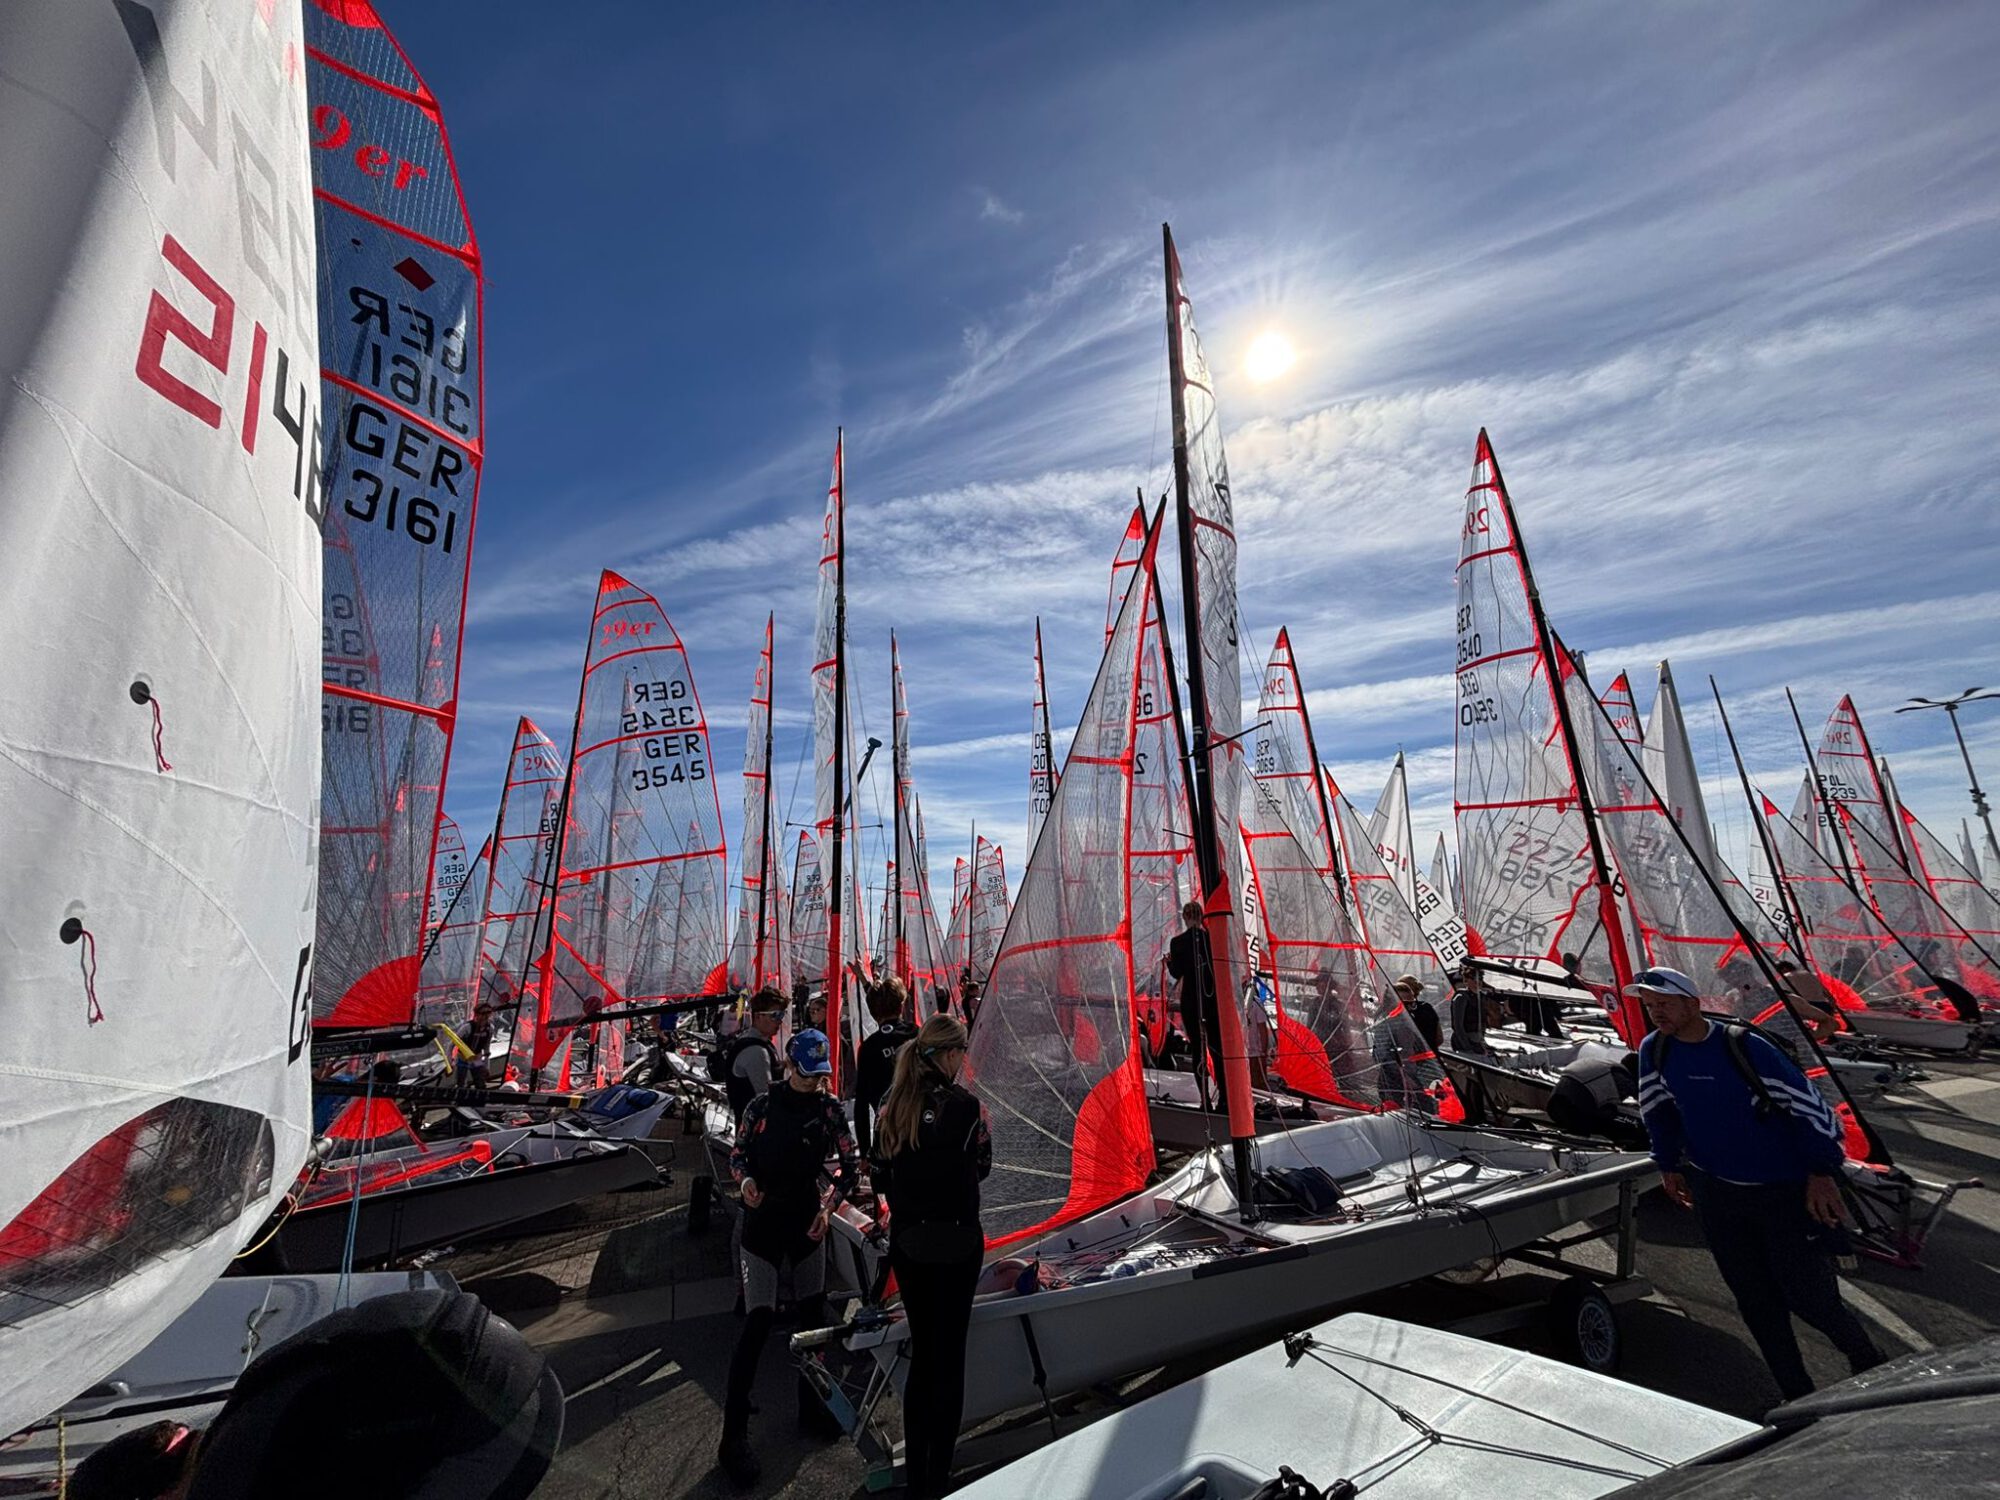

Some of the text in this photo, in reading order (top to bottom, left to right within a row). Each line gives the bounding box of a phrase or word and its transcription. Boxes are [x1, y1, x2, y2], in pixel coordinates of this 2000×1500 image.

[346, 402, 463, 498] GER
[344, 468, 456, 555] 3161
[644, 733, 702, 759] GER
[632, 760, 706, 792] 3545
